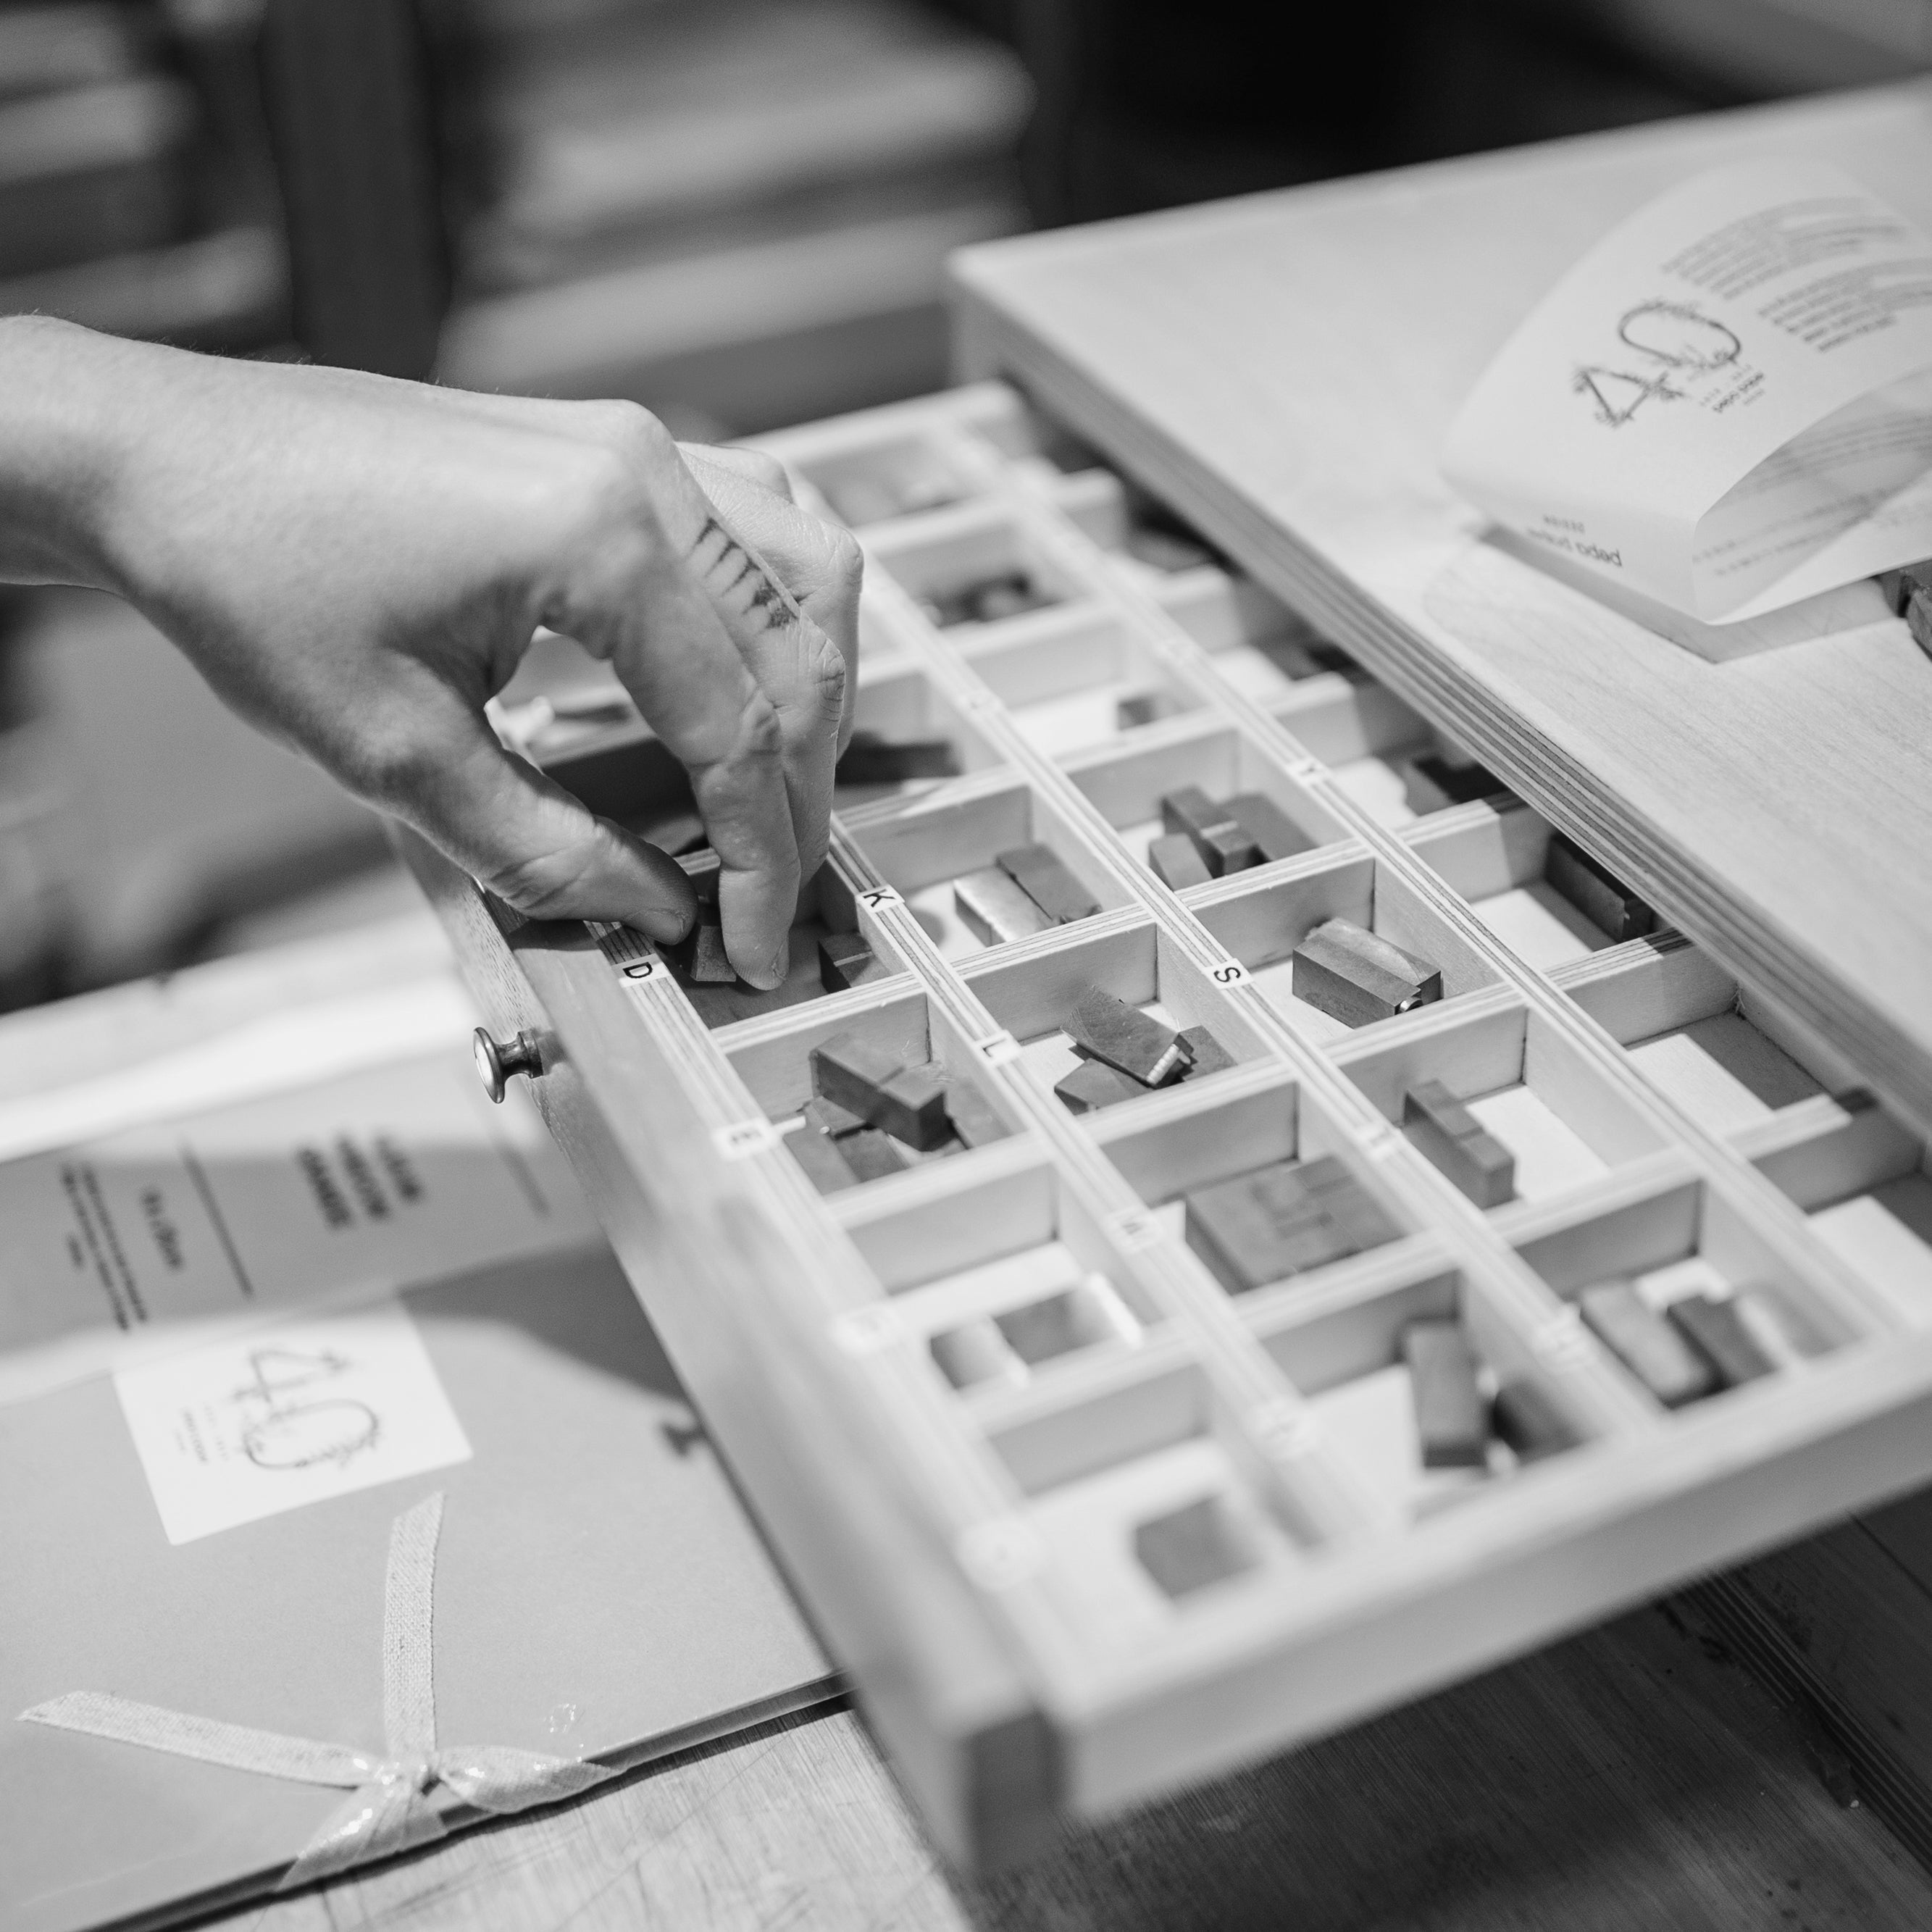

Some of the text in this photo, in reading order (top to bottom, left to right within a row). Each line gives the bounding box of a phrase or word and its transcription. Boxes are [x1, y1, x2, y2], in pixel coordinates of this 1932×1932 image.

[863, 891, 895, 908] K
[622, 961, 653, 979] D
[1213, 966, 1242, 983] S
[982, 1036, 1006, 1058] L
